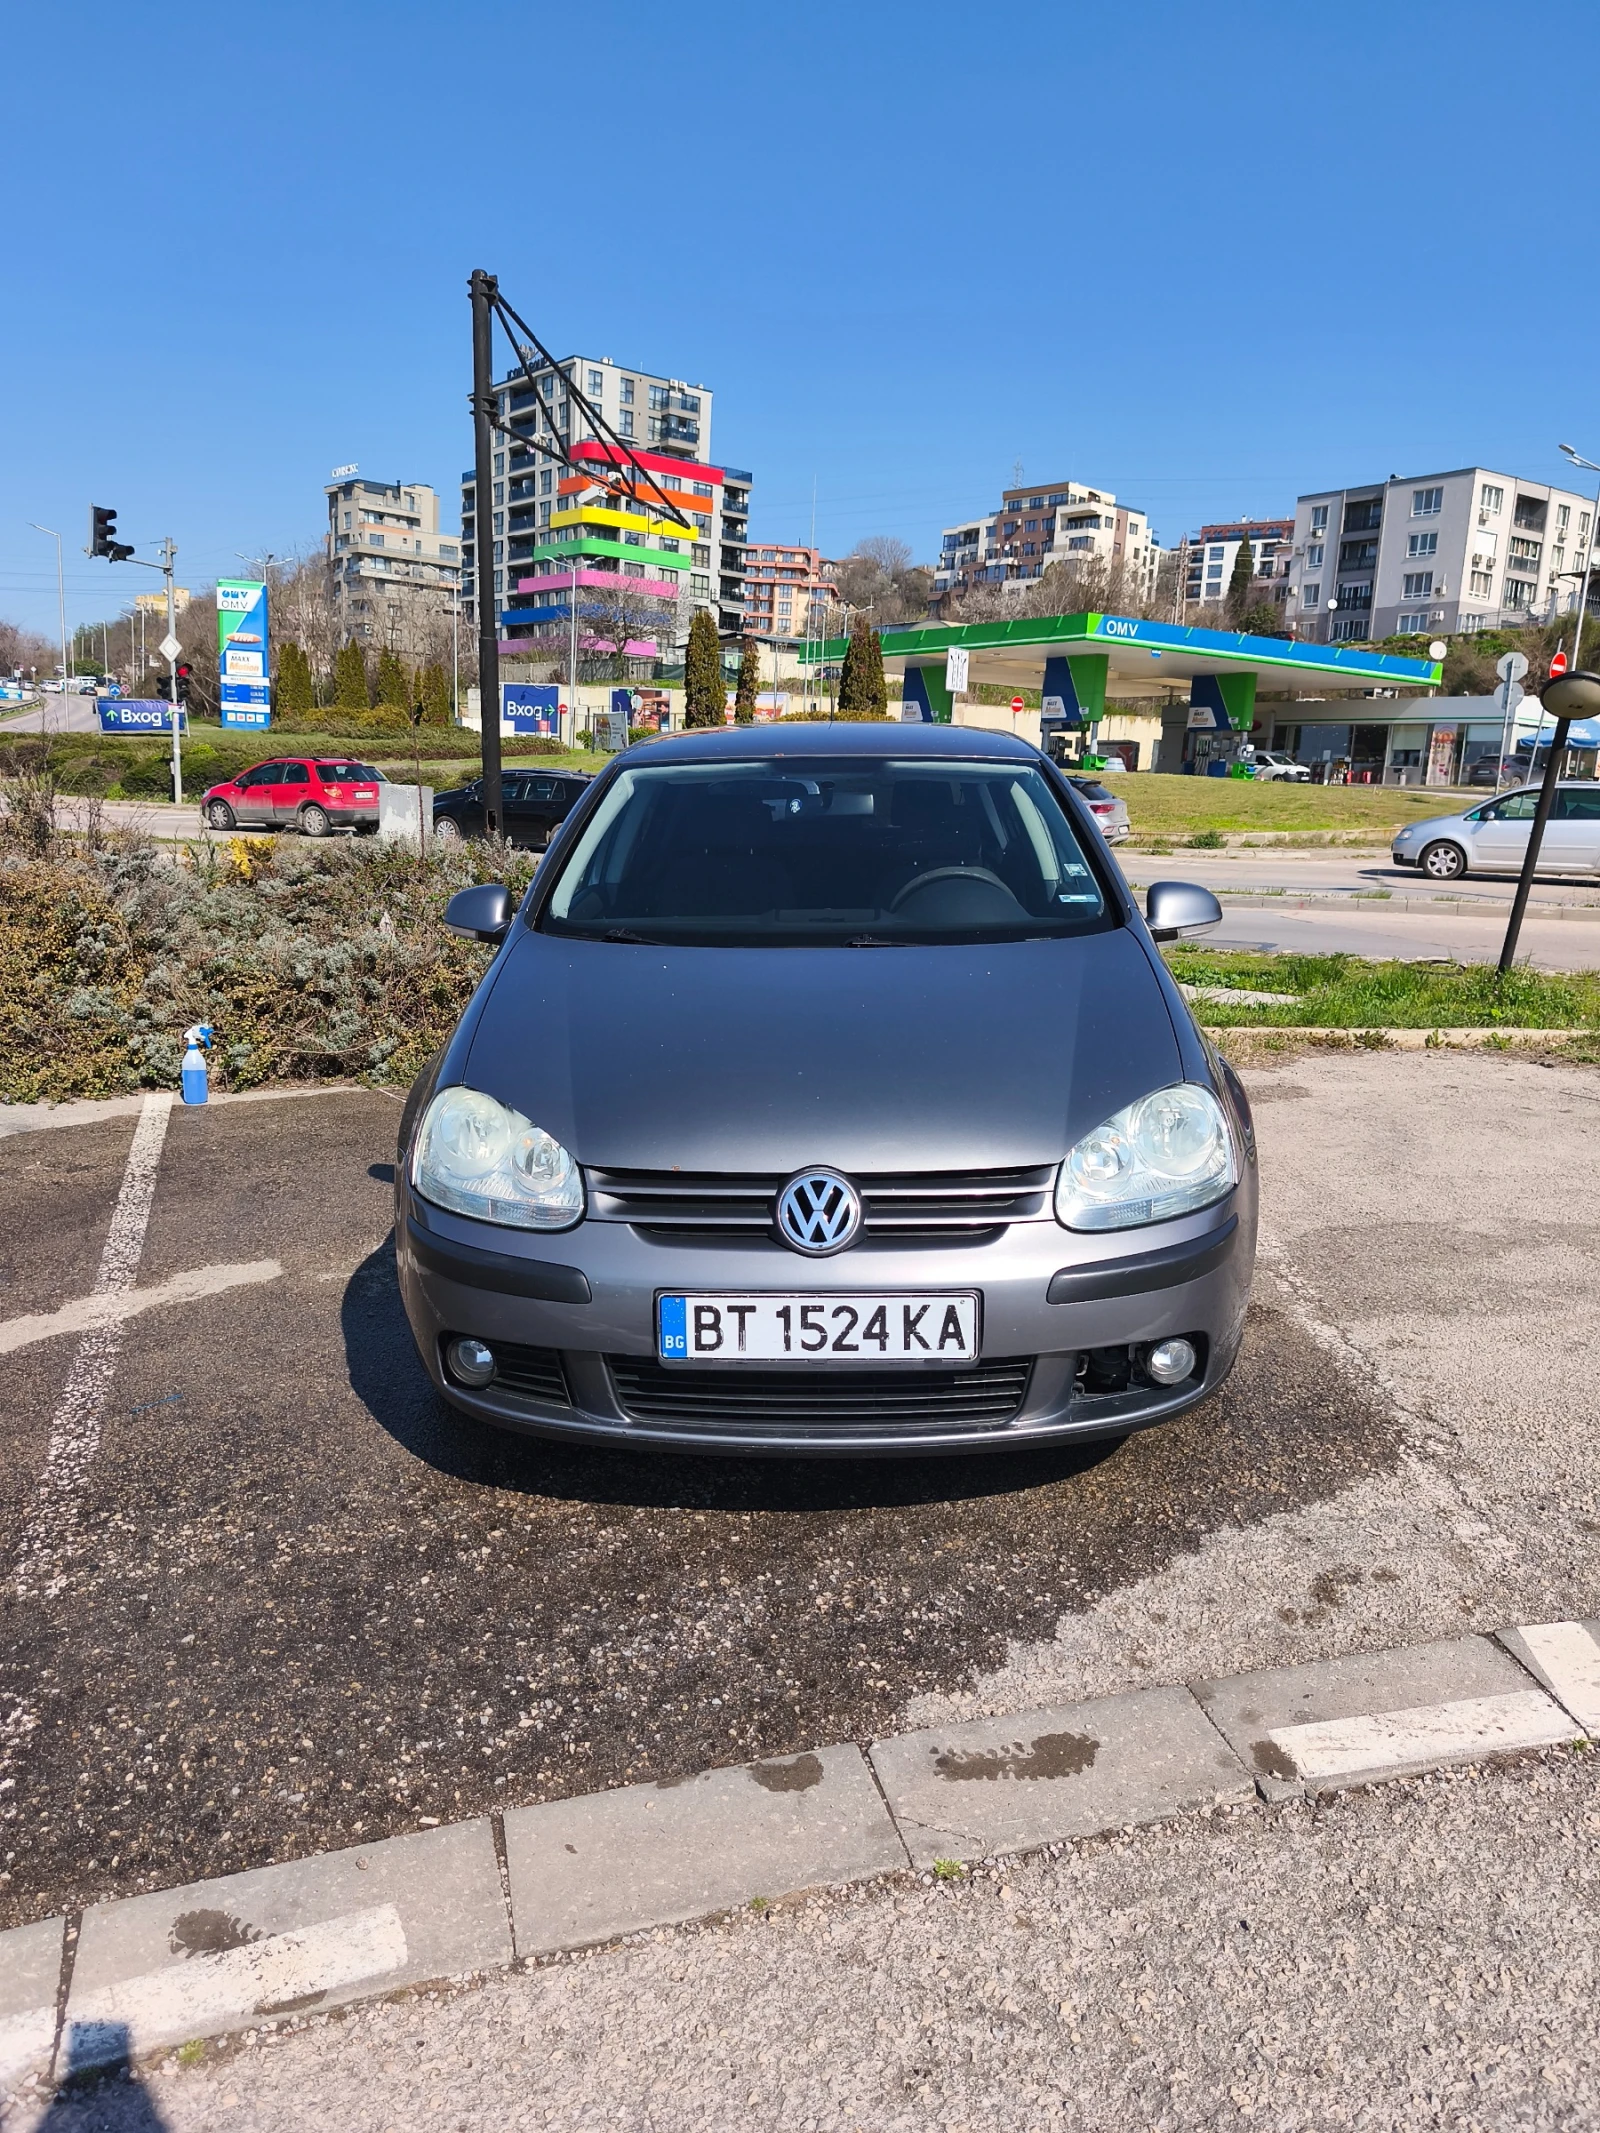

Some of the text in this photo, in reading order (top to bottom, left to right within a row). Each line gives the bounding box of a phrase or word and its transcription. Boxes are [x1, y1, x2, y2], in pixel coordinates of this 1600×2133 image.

[221, 600, 248, 609] OMV
[1106, 620, 1139, 637] OMV
[693, 1305, 966, 1351] BT 1524 KA
[665, 1335, 685, 1349] BG
